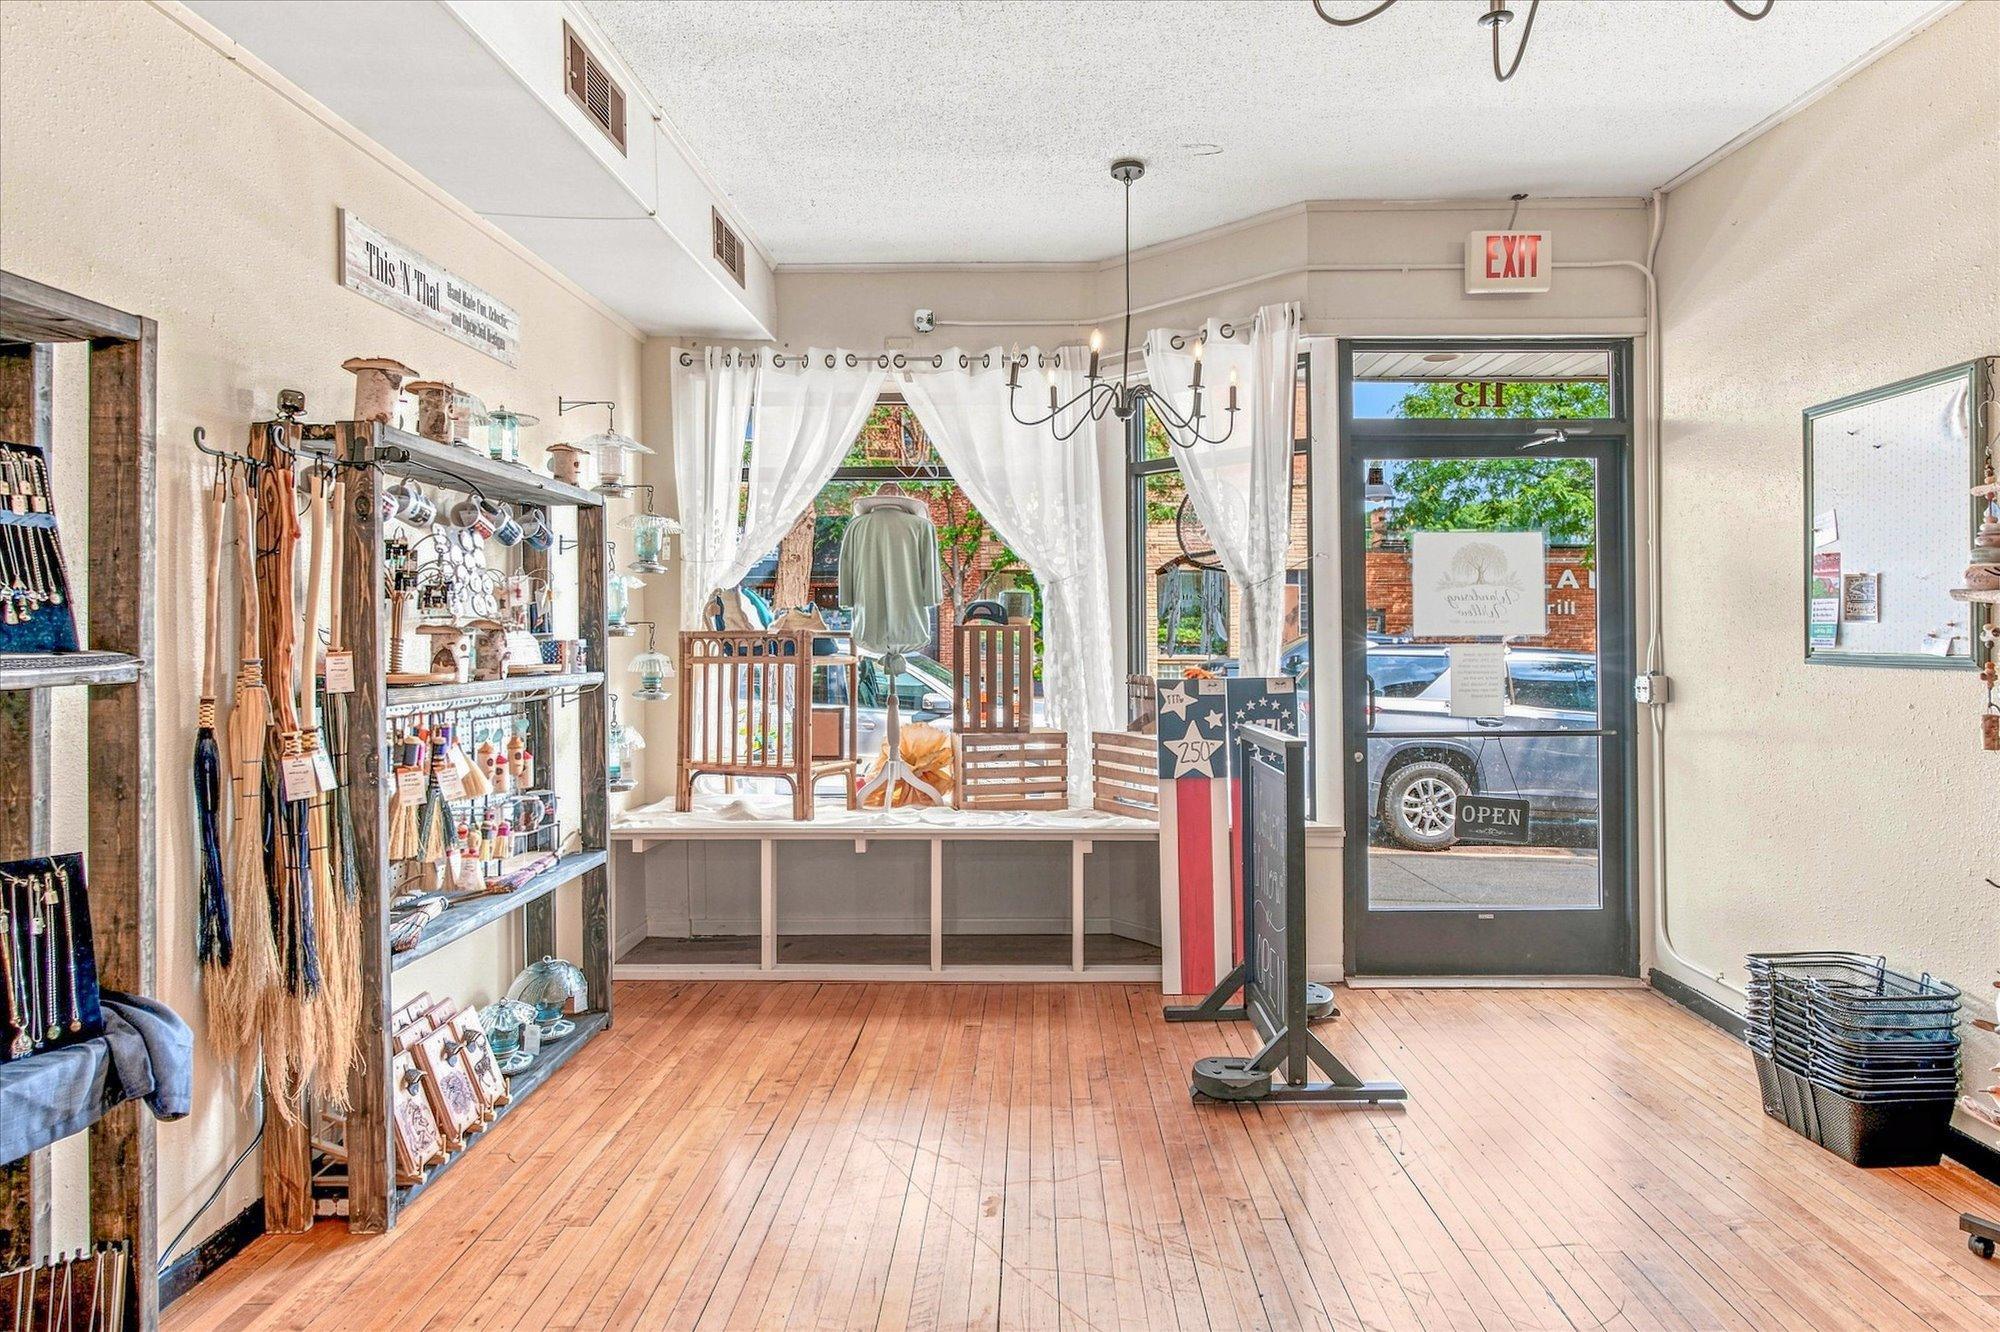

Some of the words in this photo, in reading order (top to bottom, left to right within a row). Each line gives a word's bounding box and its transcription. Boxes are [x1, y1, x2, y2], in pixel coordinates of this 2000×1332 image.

[1486, 235, 1542, 278] EXIT
[366, 241, 396, 288] This
[414, 269, 441, 313] That
[446, 281, 461, 304] Hand
[462, 291, 476, 311] Made
[451, 312, 462, 327] and
[1547, 599, 1576, 615] rill
[1461, 805, 1522, 826] OPEN
